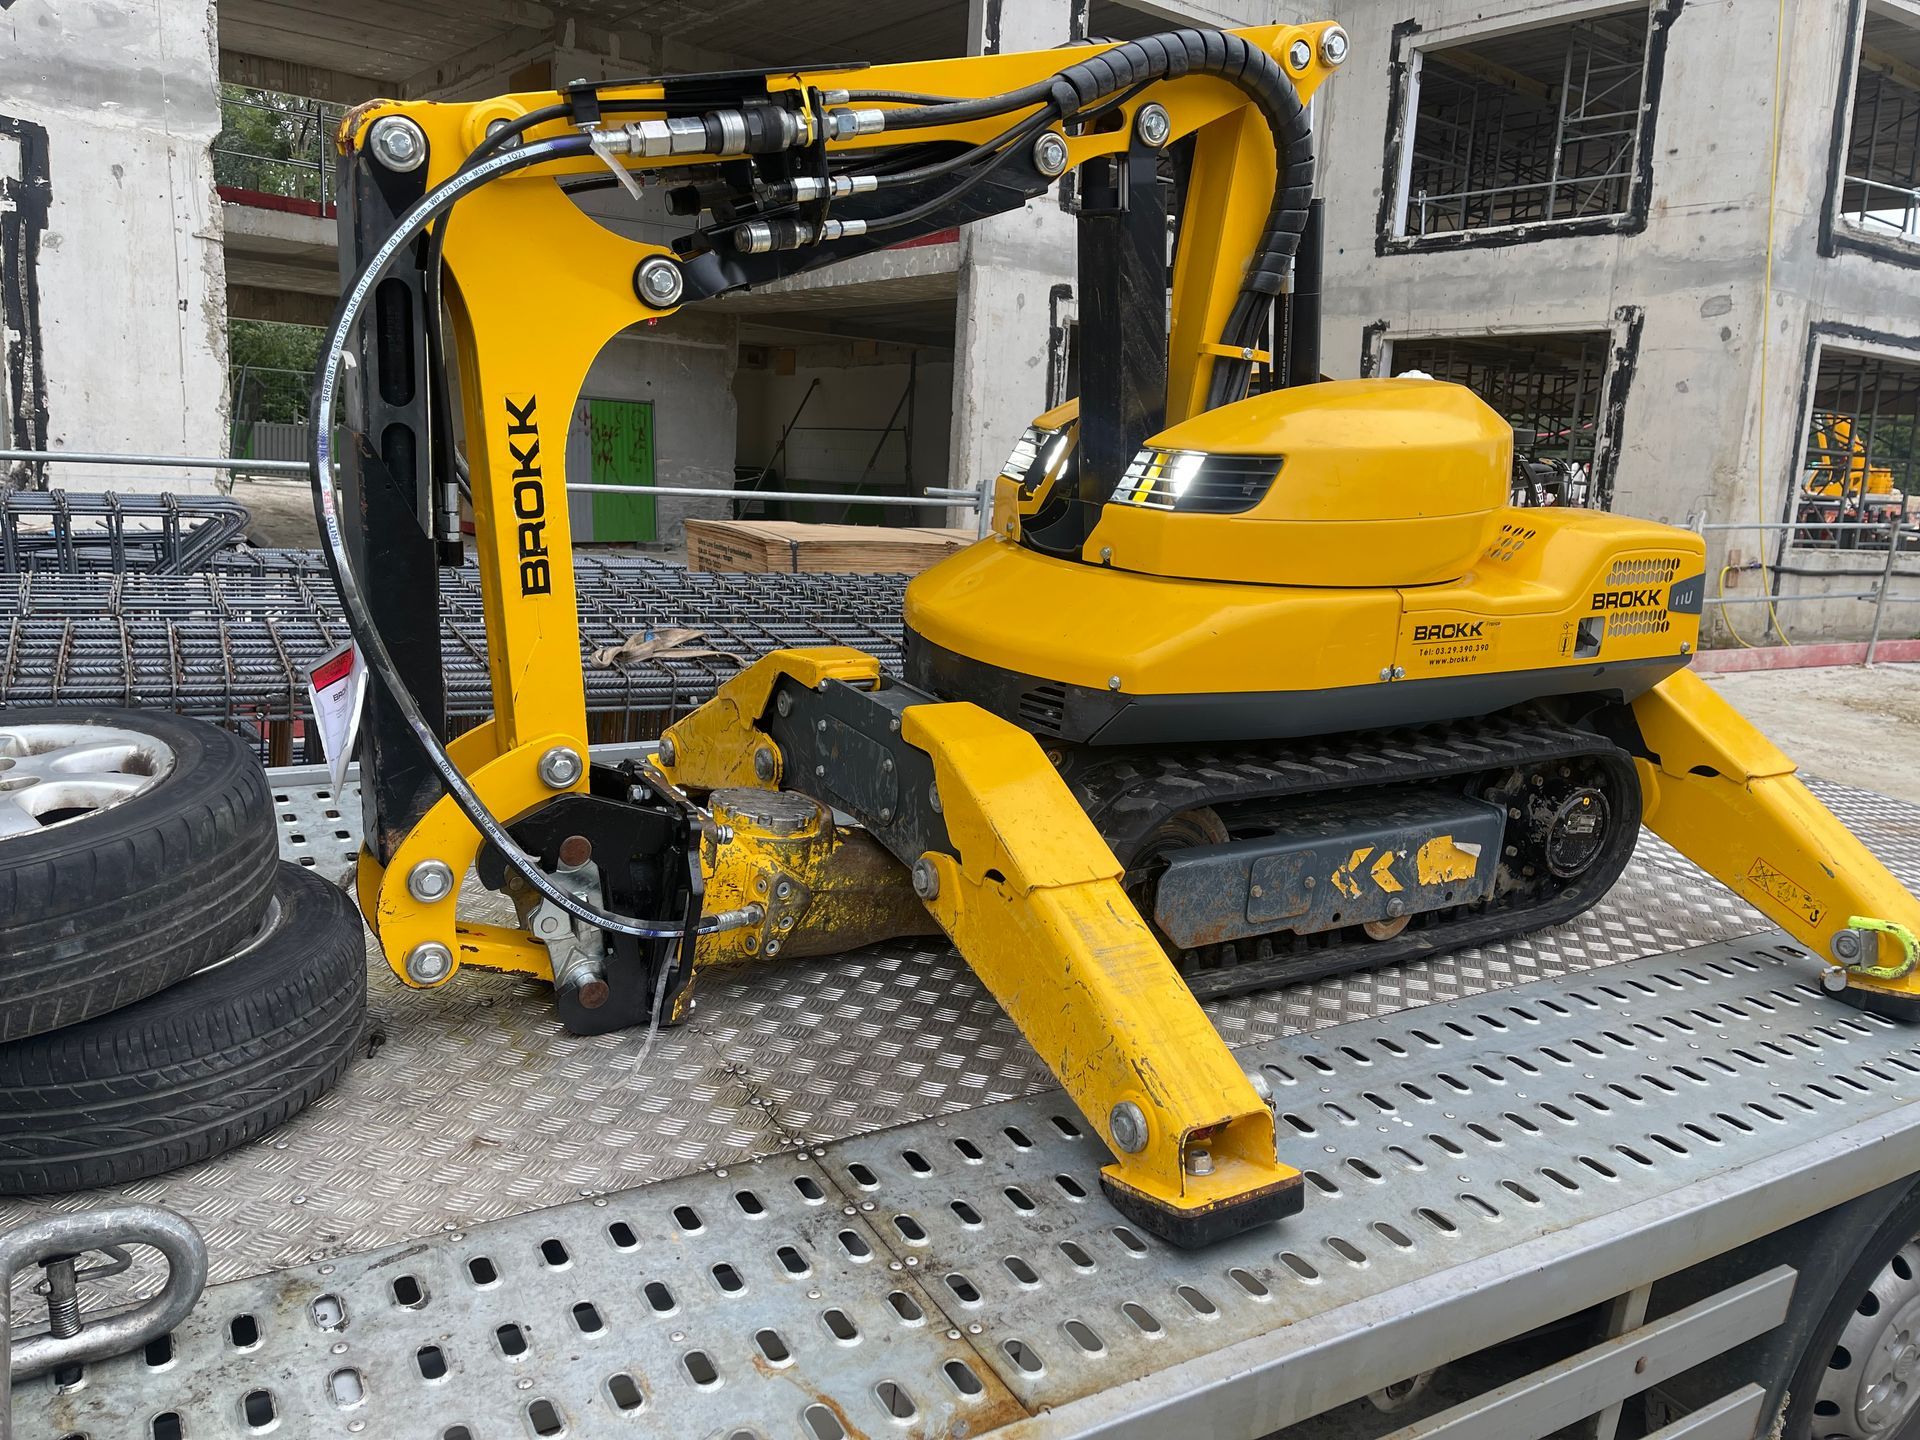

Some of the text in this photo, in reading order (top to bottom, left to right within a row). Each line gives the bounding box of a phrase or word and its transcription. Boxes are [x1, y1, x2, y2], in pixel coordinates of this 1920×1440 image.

[346, 297, 360, 315] SAE
[356, 279, 368, 298] J517
[365, 249, 389, 280] 100R2AT
[388, 238, 398, 247] ID
[408, 206, 428, 225] 12mm
[429, 195, 441, 206] WP
[440, 185, 453, 197] 275
[454, 176, 469, 189] BAR
[472, 162, 494, 177] MSHA
[507, 151, 526, 161] 1Q23
[504, 394, 551, 597] BROKK
[1591, 589, 1662, 610] BROKK
[1414, 622, 1484, 640] BROKK
[1435, 644, 1489, 655] 03.29.390.390
[1429, 655, 1477, 665] www.brokk.fr
[438, 759, 452, 776] 1Q23
[471, 804, 483, 818] BAR
